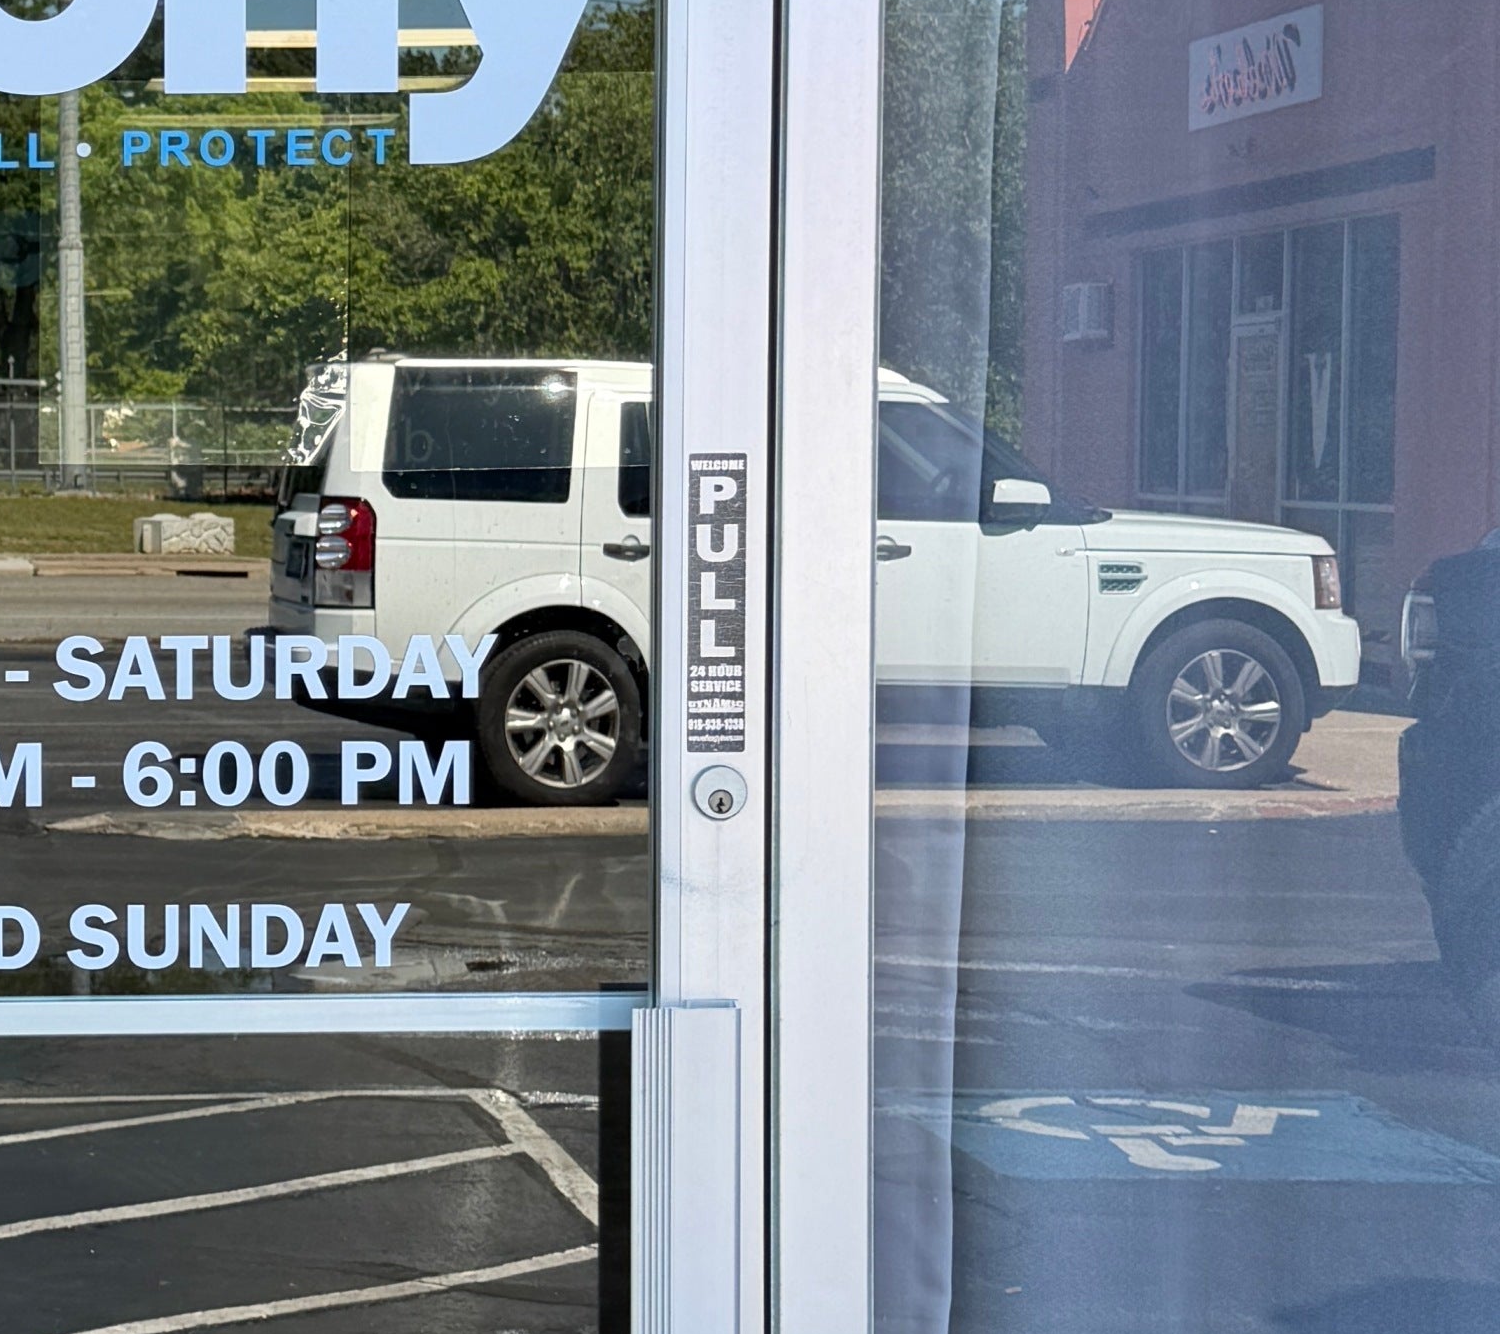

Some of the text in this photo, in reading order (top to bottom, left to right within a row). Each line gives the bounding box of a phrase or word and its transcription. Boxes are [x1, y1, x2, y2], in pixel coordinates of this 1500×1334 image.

[122, 127, 396, 168] PROTECT
[690, 459, 745, 471] WELCOME
[696, 476, 739, 658] PULL
[53, 634, 499, 703] SATURDAY
[690, 665, 742, 677] 24 HOUR
[690, 680, 742, 693] SERVICE
[122, 739, 310, 807] 6:00
[341, 739, 472, 806] PM
[66, 902, 412, 972] SUNDAY
